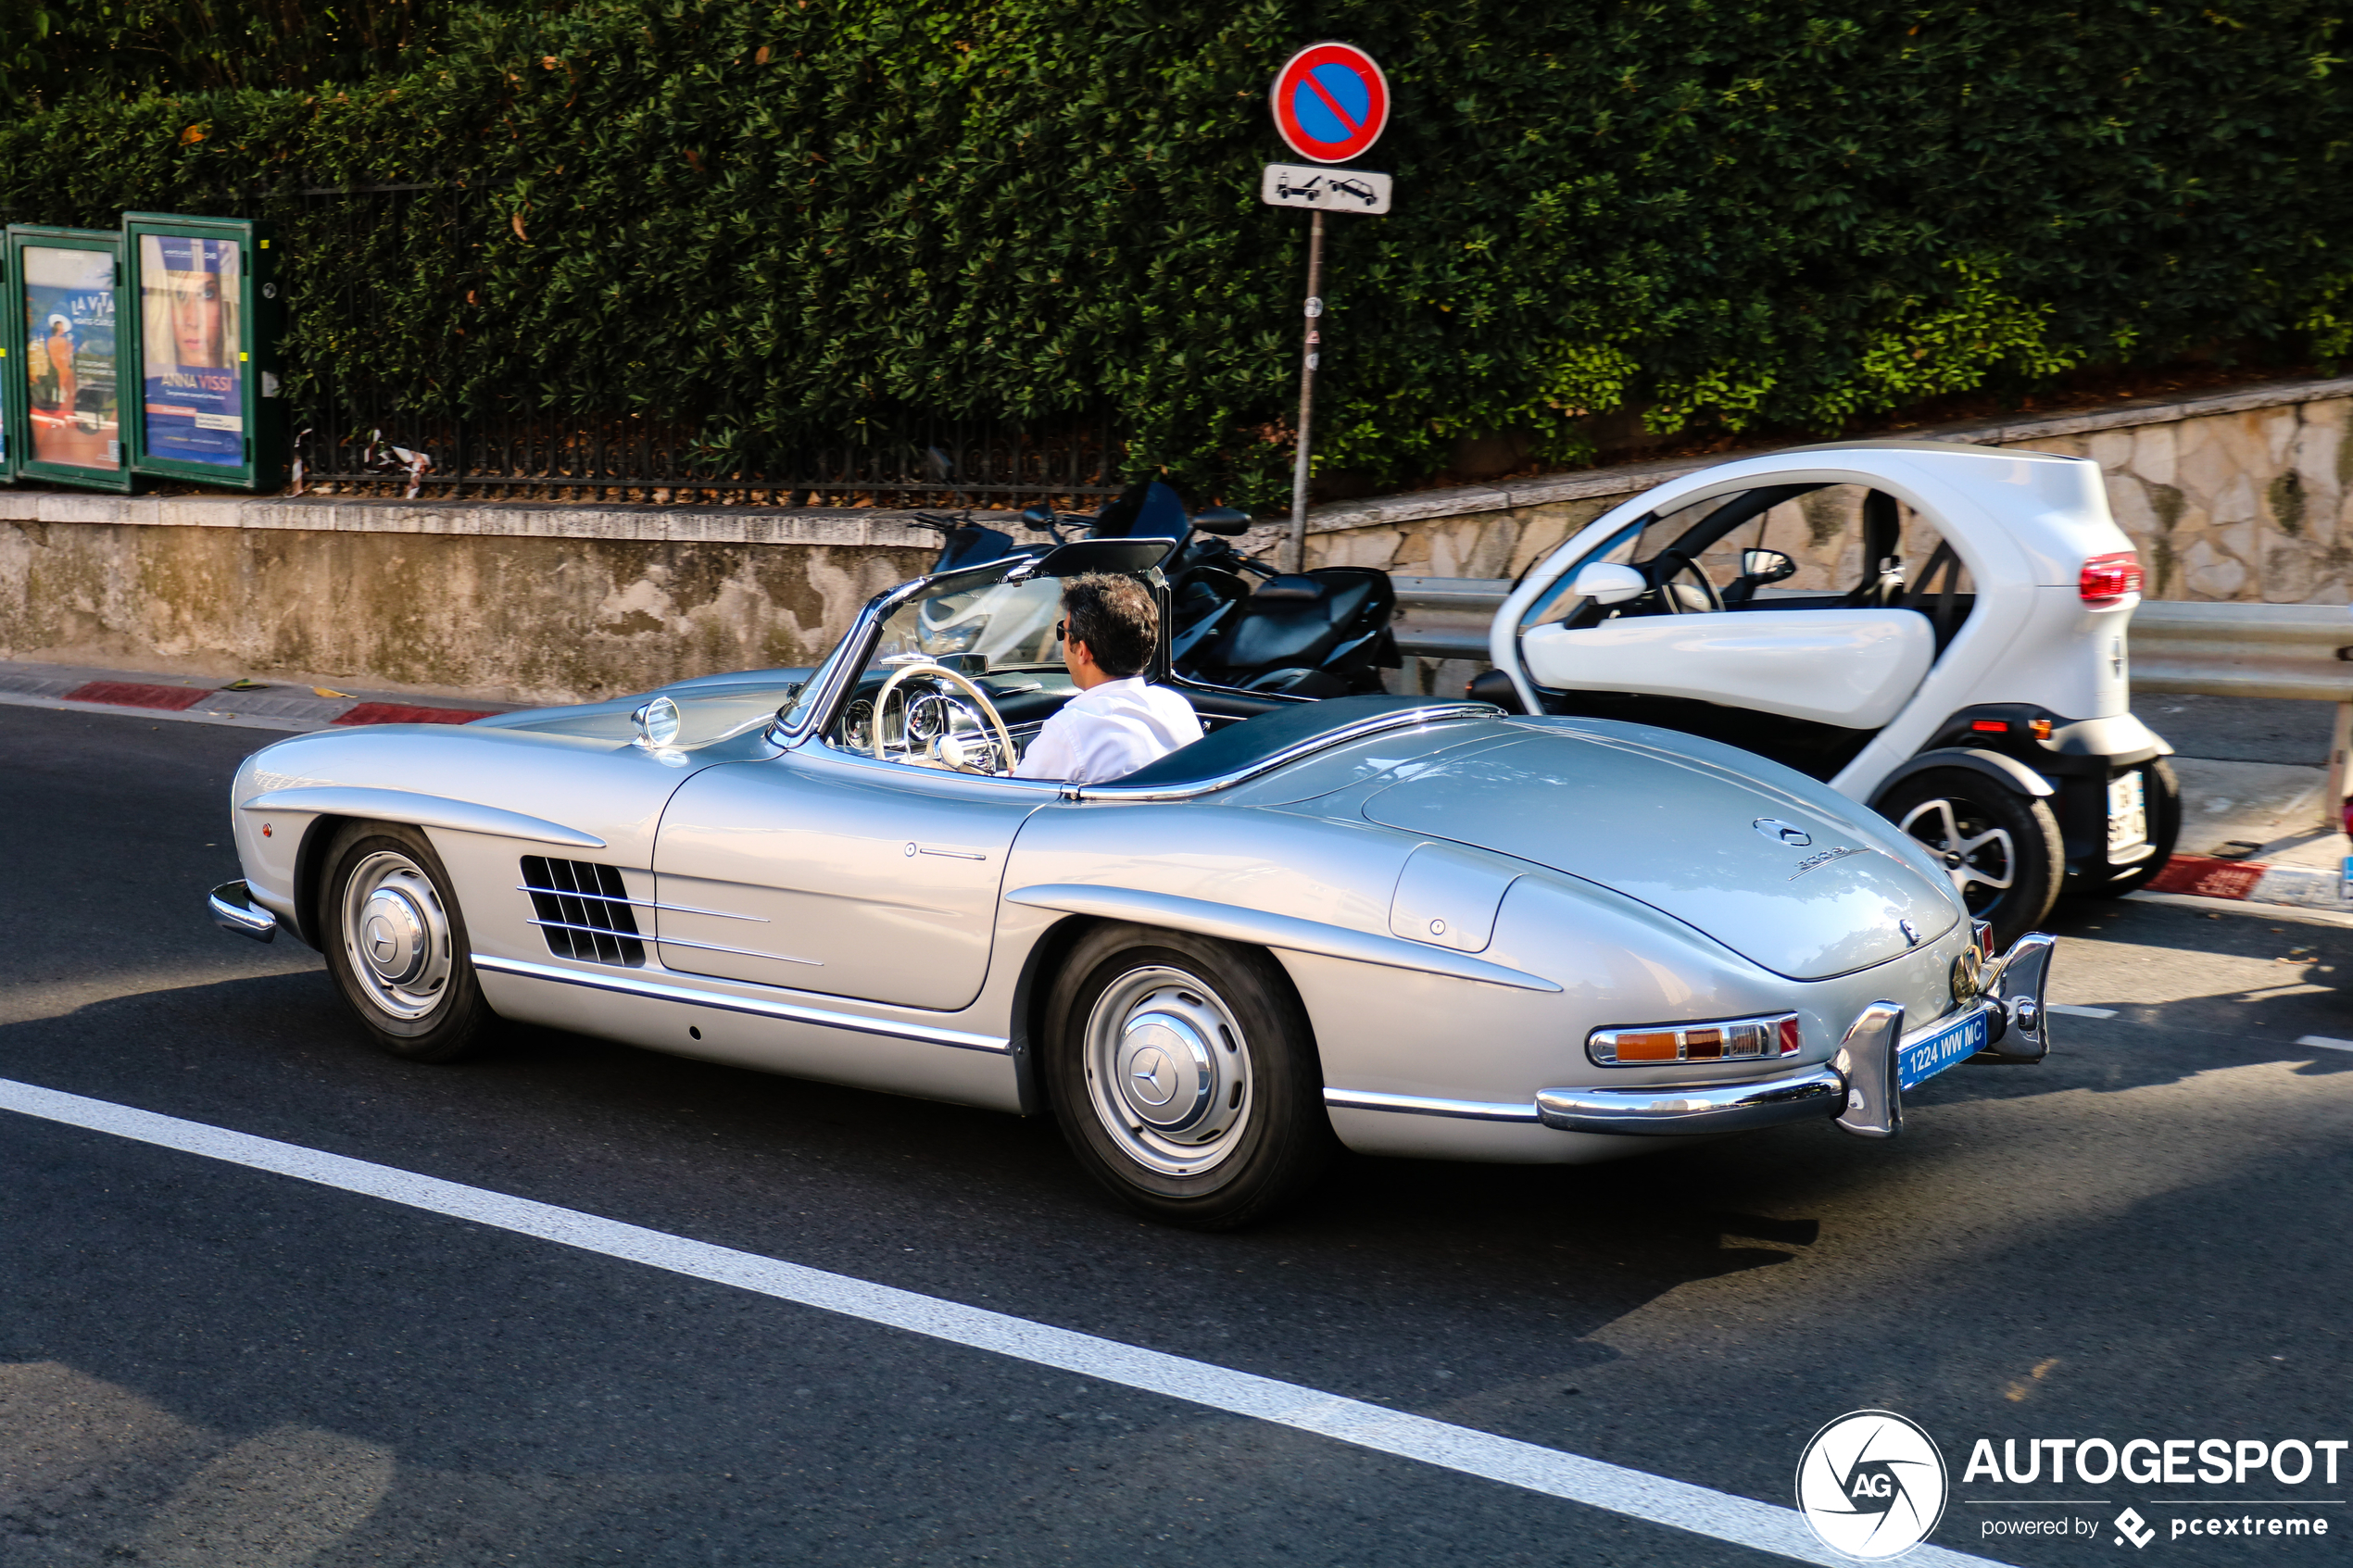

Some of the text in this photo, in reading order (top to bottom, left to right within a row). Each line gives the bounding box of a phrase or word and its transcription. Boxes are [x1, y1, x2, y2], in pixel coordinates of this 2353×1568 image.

[71, 292, 115, 317] LA VITA
[160, 372, 233, 392] ANNA VISSI
[1910, 1042, 1938, 1073] 1224
[1941, 1029, 1963, 1060] WW
[1965, 1020, 1982, 1047] MC
